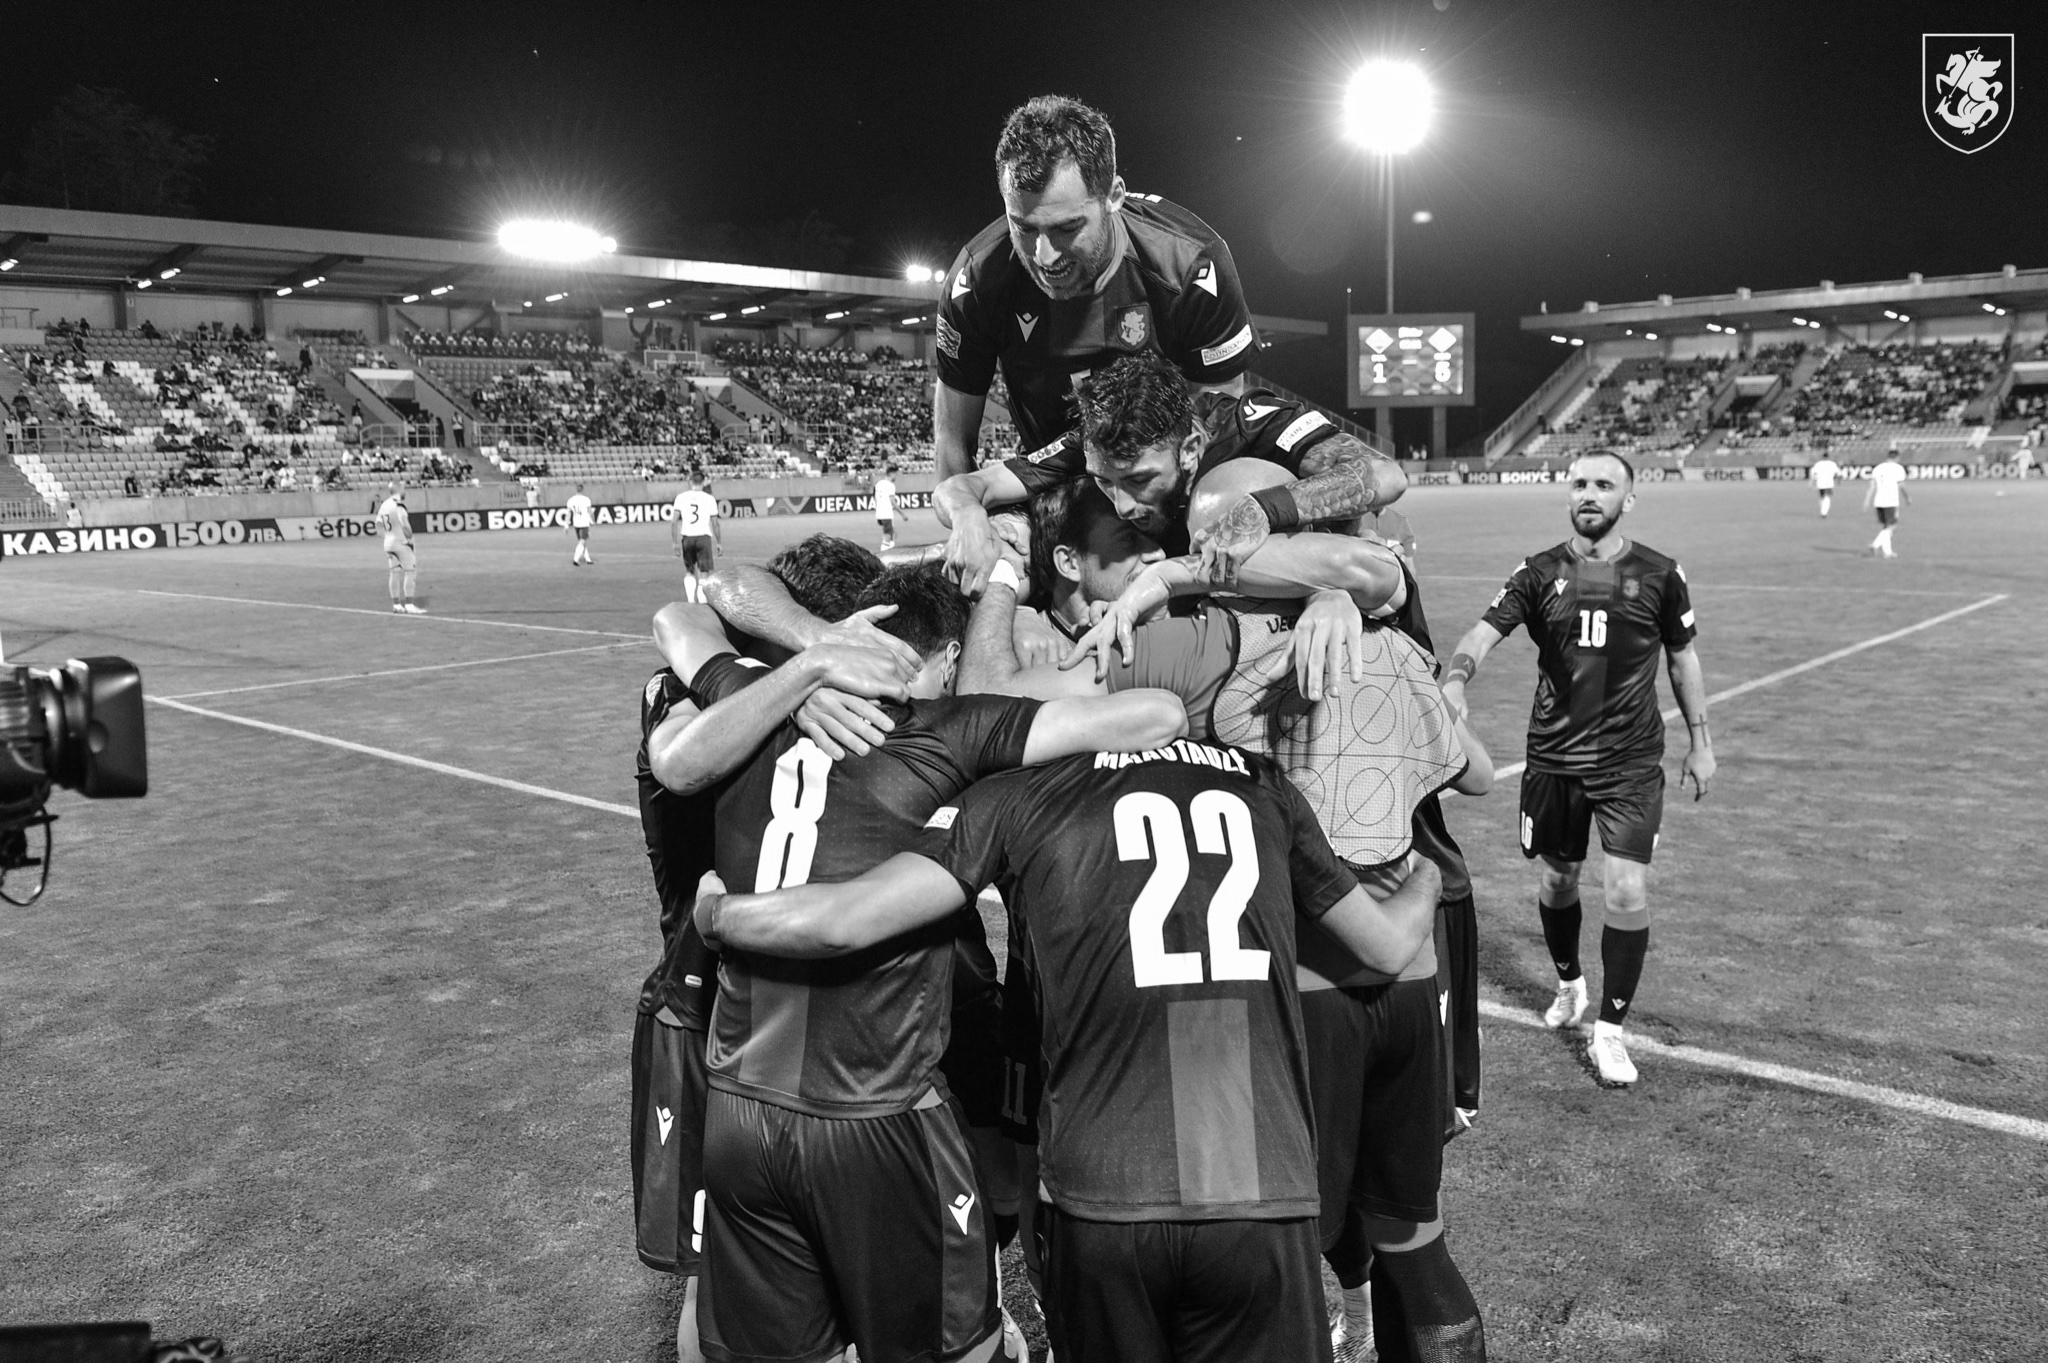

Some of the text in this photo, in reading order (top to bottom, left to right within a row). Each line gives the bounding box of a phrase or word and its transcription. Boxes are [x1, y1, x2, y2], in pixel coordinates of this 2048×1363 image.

[1373, 363, 1387, 383] 1
[1500, 471, 1550, 483] БОНУС
[1704, 469, 1744, 481] efbet
[1907, 464, 1965, 479] ЗИНО
[815, 496, 854, 513] UEFA
[856, 493, 920, 511] NANS
[426, 512, 482, 532] НОВ
[690, 503, 700, 525] 3
[2, 520, 283, 556] КАЗИНО 1500 лв.
[317, 518, 378, 538] efbe
[1578, 609, 1608, 648] 16
[755, 737, 833, 894] 8
[1521, 810, 1534, 850] 16
[1113, 789, 1271, 987] 22
